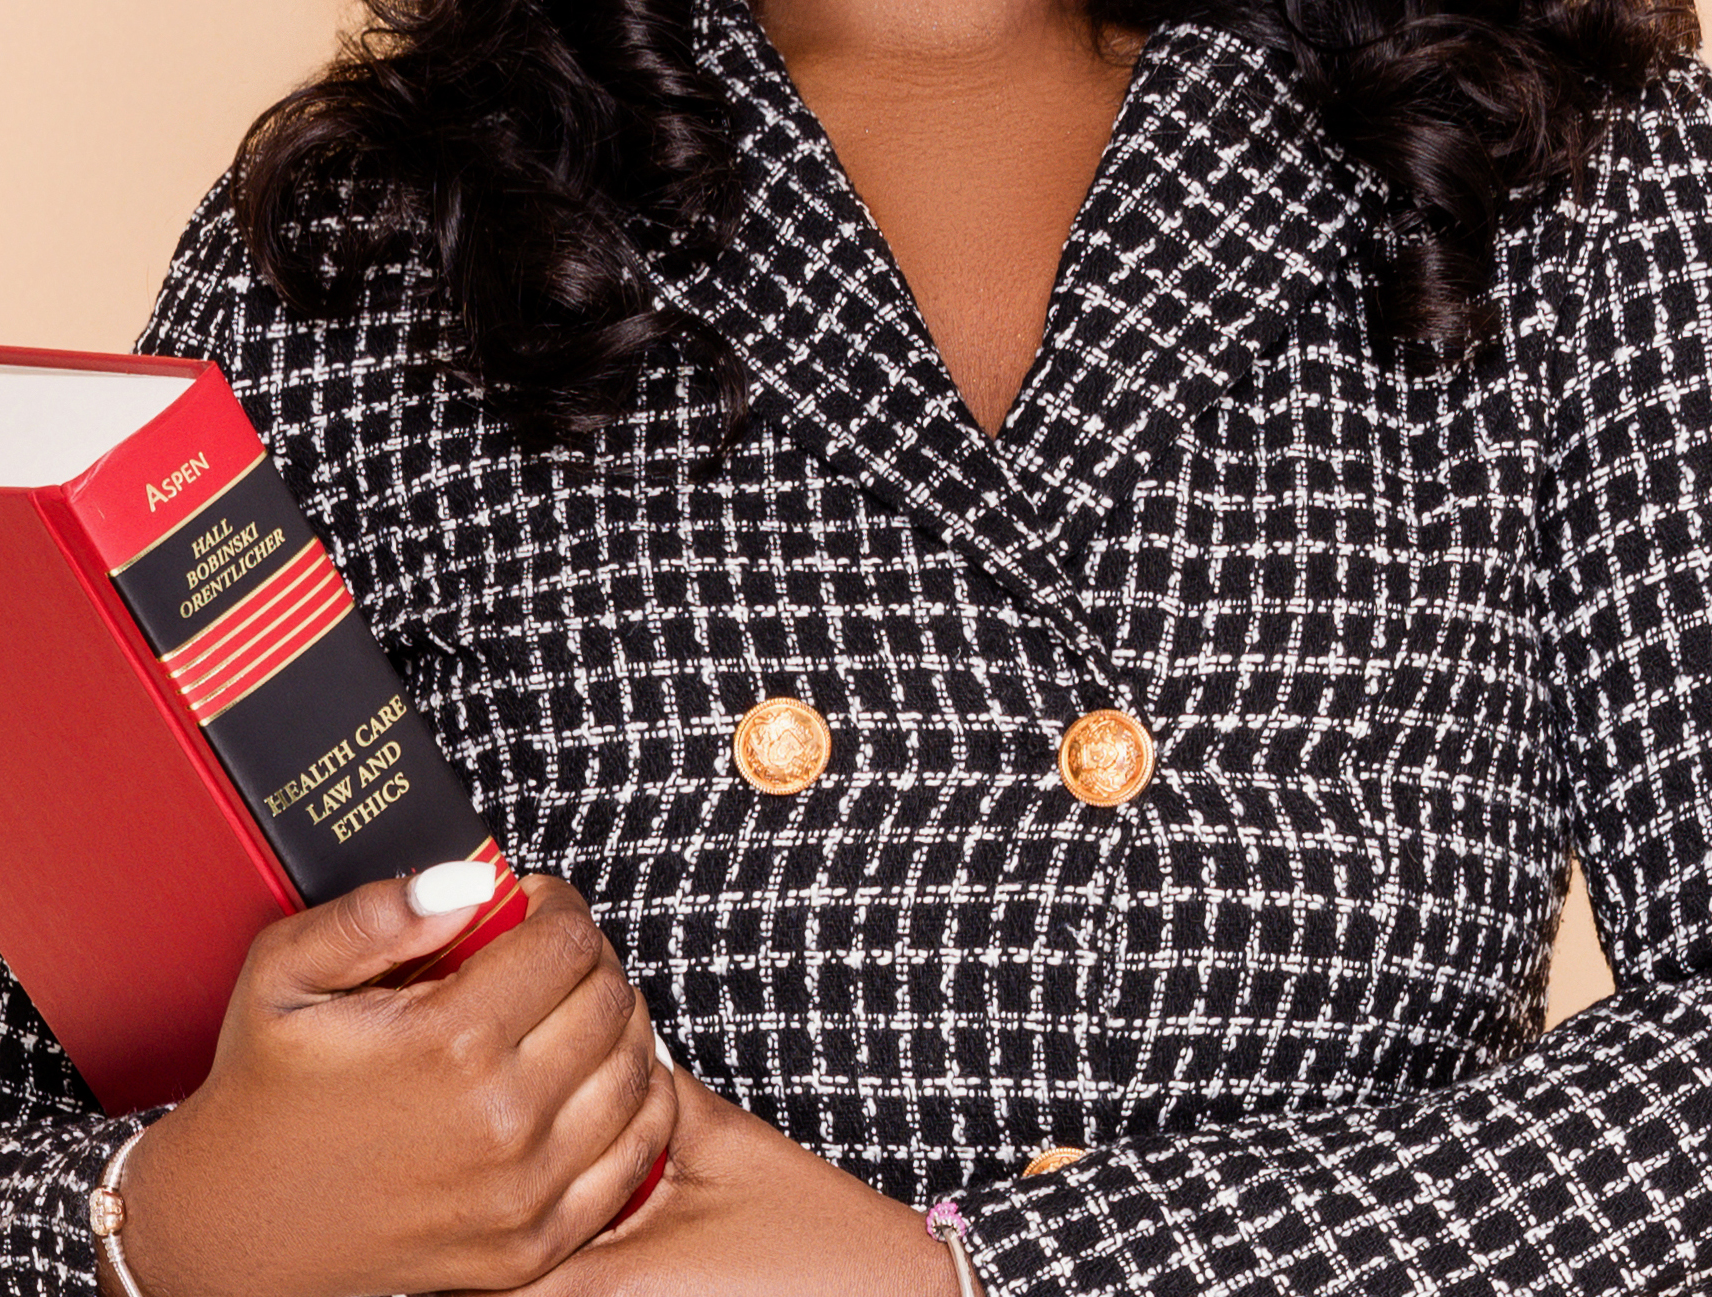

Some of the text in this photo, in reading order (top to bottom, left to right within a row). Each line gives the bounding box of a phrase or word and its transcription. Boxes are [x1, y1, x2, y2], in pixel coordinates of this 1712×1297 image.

[179, 527, 286, 619] ORENTLICHER
[186, 521, 259, 590] BOBINSKI
[191, 518, 233, 560] HALL
[263, 694, 407, 818] HEALTH CARE
[305, 741, 402, 826] LAW AND
[331, 771, 410, 844] ETHICS
